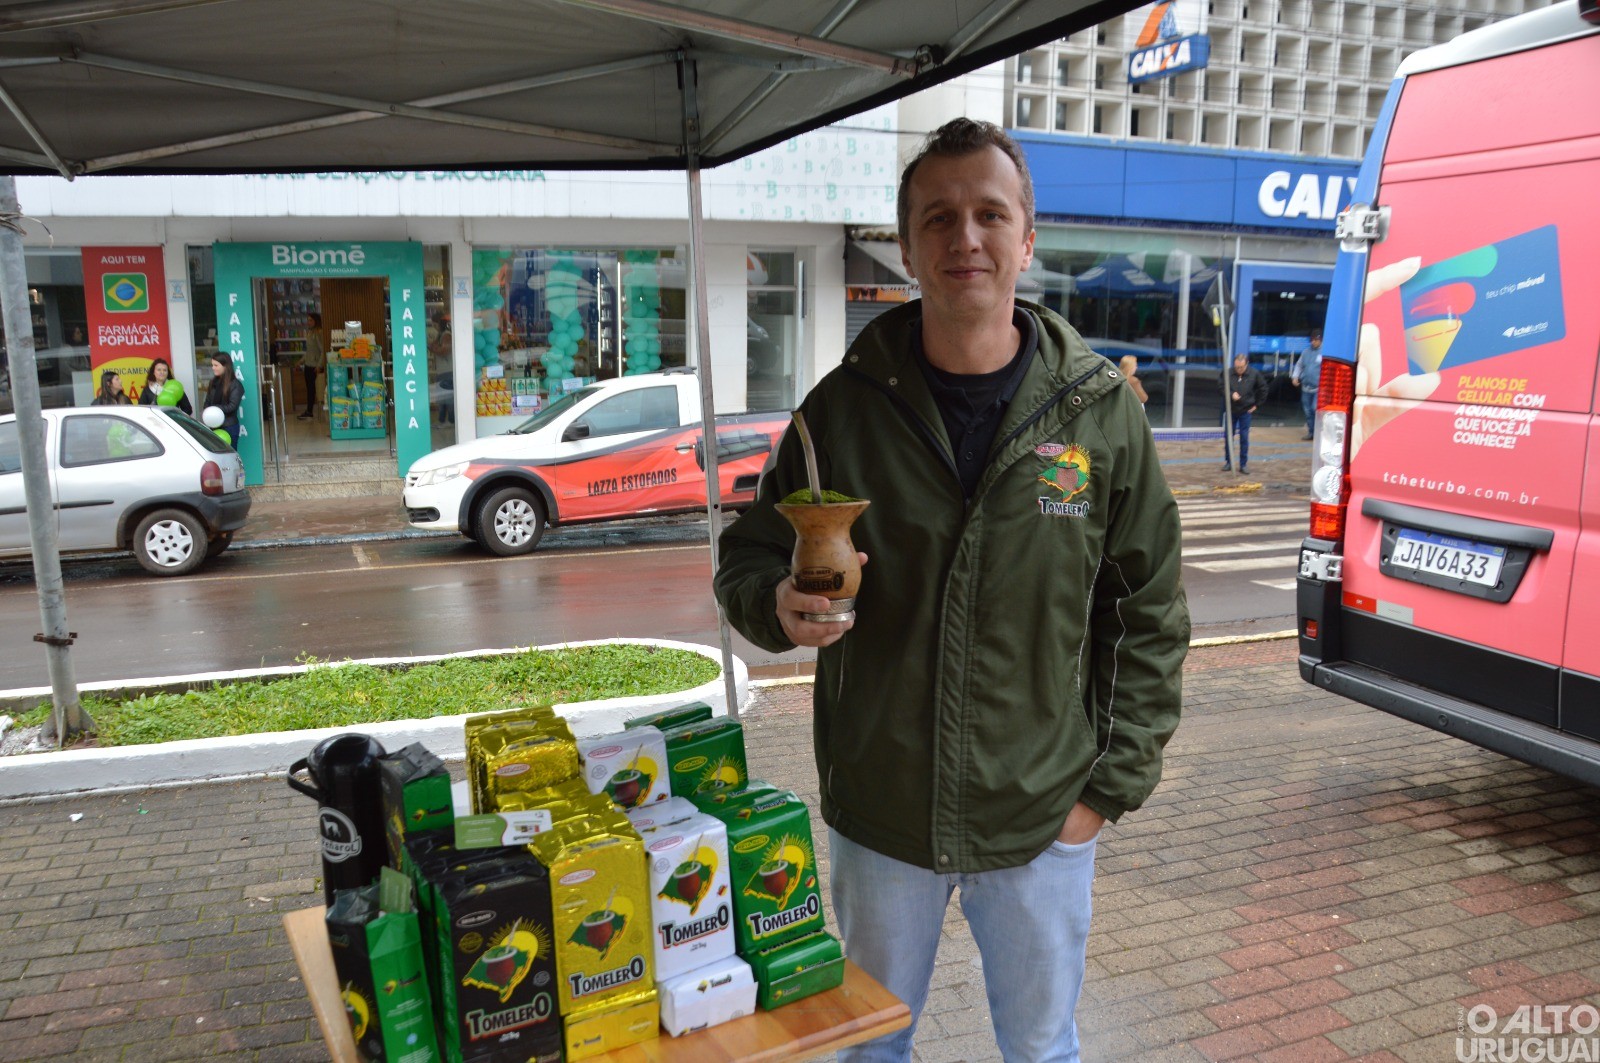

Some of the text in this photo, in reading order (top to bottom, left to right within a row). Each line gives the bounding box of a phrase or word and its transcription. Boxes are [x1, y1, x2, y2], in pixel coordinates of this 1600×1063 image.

[1130, 39, 1191, 78] CAIXA
[1258, 171, 1358, 219] CAI
[100, 256, 124, 264] AQUI
[272, 244, 365, 266] Biomē
[98, 323, 159, 335] FARMÁCIA
[99, 335, 160, 347] POPULAR
[229, 293, 248, 438] FARMÁIA
[402, 289, 419, 429] FARMÁCIA
[102, 367, 149, 375] MEDICAMEN
[1458, 376, 1528, 391] PLANOS DE
[1456, 390, 1546, 407] CELULAR COM
[1455, 405, 1540, 423] A QUALIDADE
[1454, 418, 1480, 431] QUE
[1514, 420, 1531, 437] JÁ
[1453, 431, 1517, 449] CONHECE!
[587, 468, 677, 497] LAZZA ESTOFADOS
[1383, 472, 1540, 506] tcheturbo.com.br
[1400, 541, 1490, 578] JAV6A33
